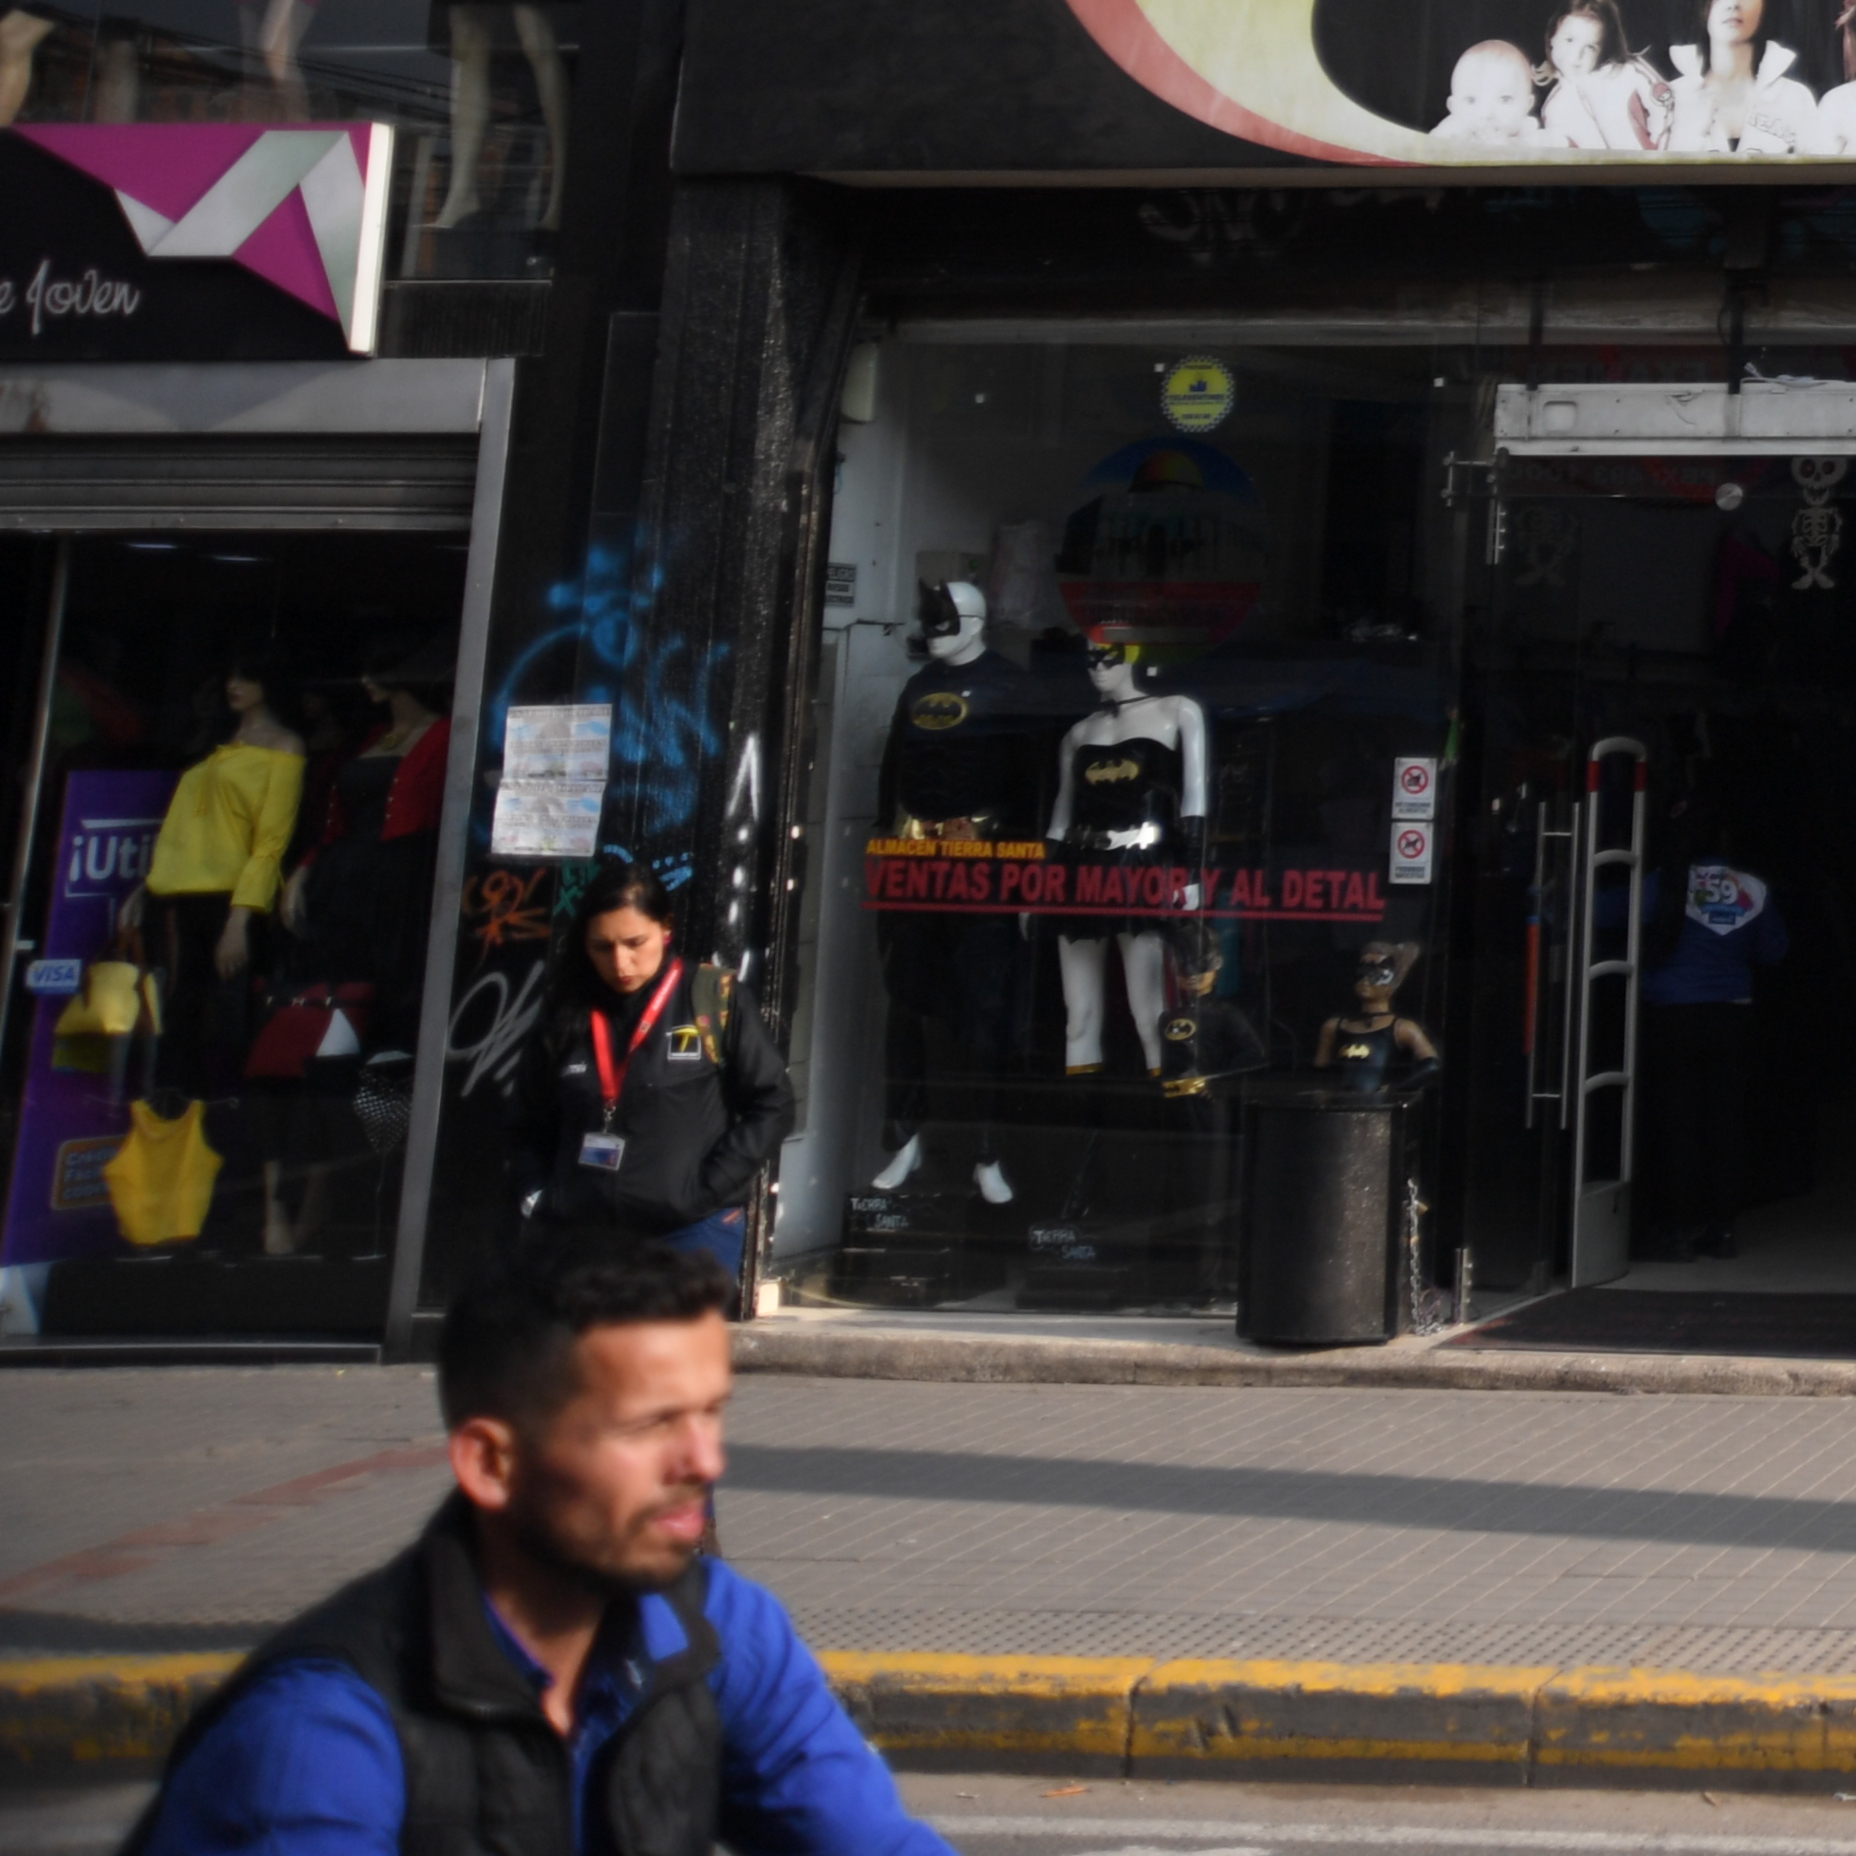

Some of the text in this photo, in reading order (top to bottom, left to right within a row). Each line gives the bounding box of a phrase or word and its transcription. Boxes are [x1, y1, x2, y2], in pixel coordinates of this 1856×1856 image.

[866, 839, 1047, 860] ALMACEN TIERRA SANTA
[863, 858, 1386, 912] VENTAS POR MAYOR Y AL DETAL
[32, 965, 76, 983] VISA
